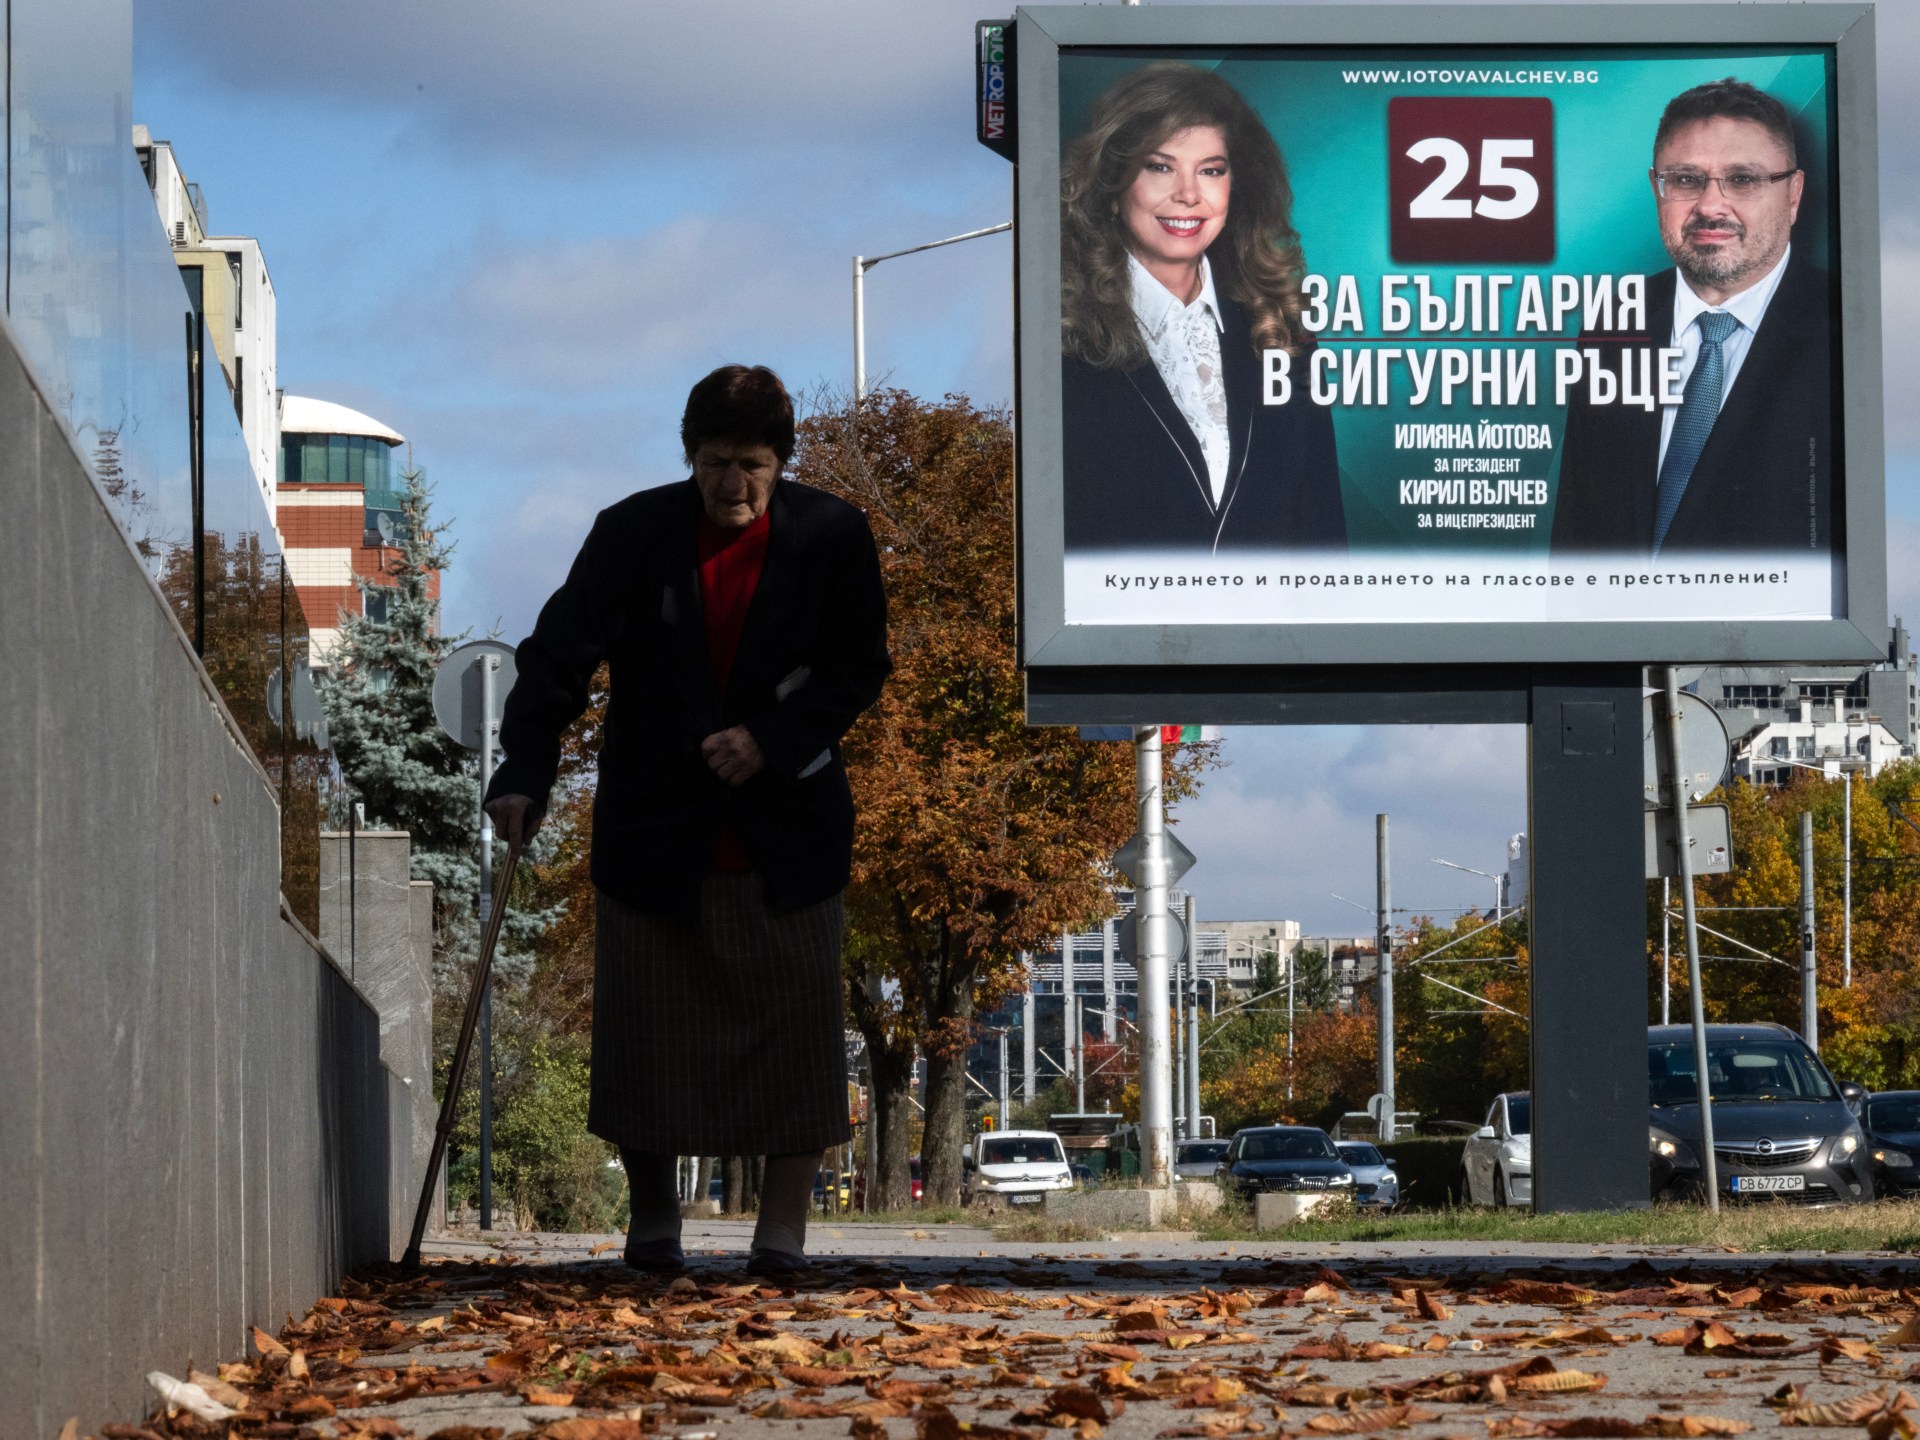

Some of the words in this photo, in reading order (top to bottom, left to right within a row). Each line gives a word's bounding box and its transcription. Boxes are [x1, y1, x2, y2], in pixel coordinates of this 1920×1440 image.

[1342, 70, 1599, 84] WWW.IOTOVAVALCHEV.BG
[1405, 137, 1539, 220] 25
[1301, 274, 1364, 332] ЗА
[1382, 274, 1646, 332] БЪЛГАРИЯ
[1262, 348, 1292, 406] В
[1310, 348, 1537, 406] СИГУРНИ
[1555, 348, 1684, 412] РЪЦЕ
[1395, 424, 1474, 449] ИЛИЯНА
[1478, 419, 1552, 449] ЙОТОВА
[1434, 458, 1449, 472] ЗА
[1453, 458, 1521, 474] ПРЕЗИДЕНТ
[1400, 480, 1465, 505] КИРИЛ
[1469, 480, 1548, 505] ВЪЛЧЕВ
[1418, 514, 1432, 528] ЗА
[1436, 514, 1536, 530] ВИЦЕПРЕЗИДЕНТ
[1105, 574, 1244, 590] Купуването
[1256, 573, 1267, 586] и
[1279, 573, 1434, 588] продаването
[1445, 573, 1471, 585] на
[1483, 573, 1575, 586] гласове
[1586, 574, 1597, 585] е
[1609, 571, 1789, 588] престъпление!
[1757, 1177, 1786, 1190] 6772
